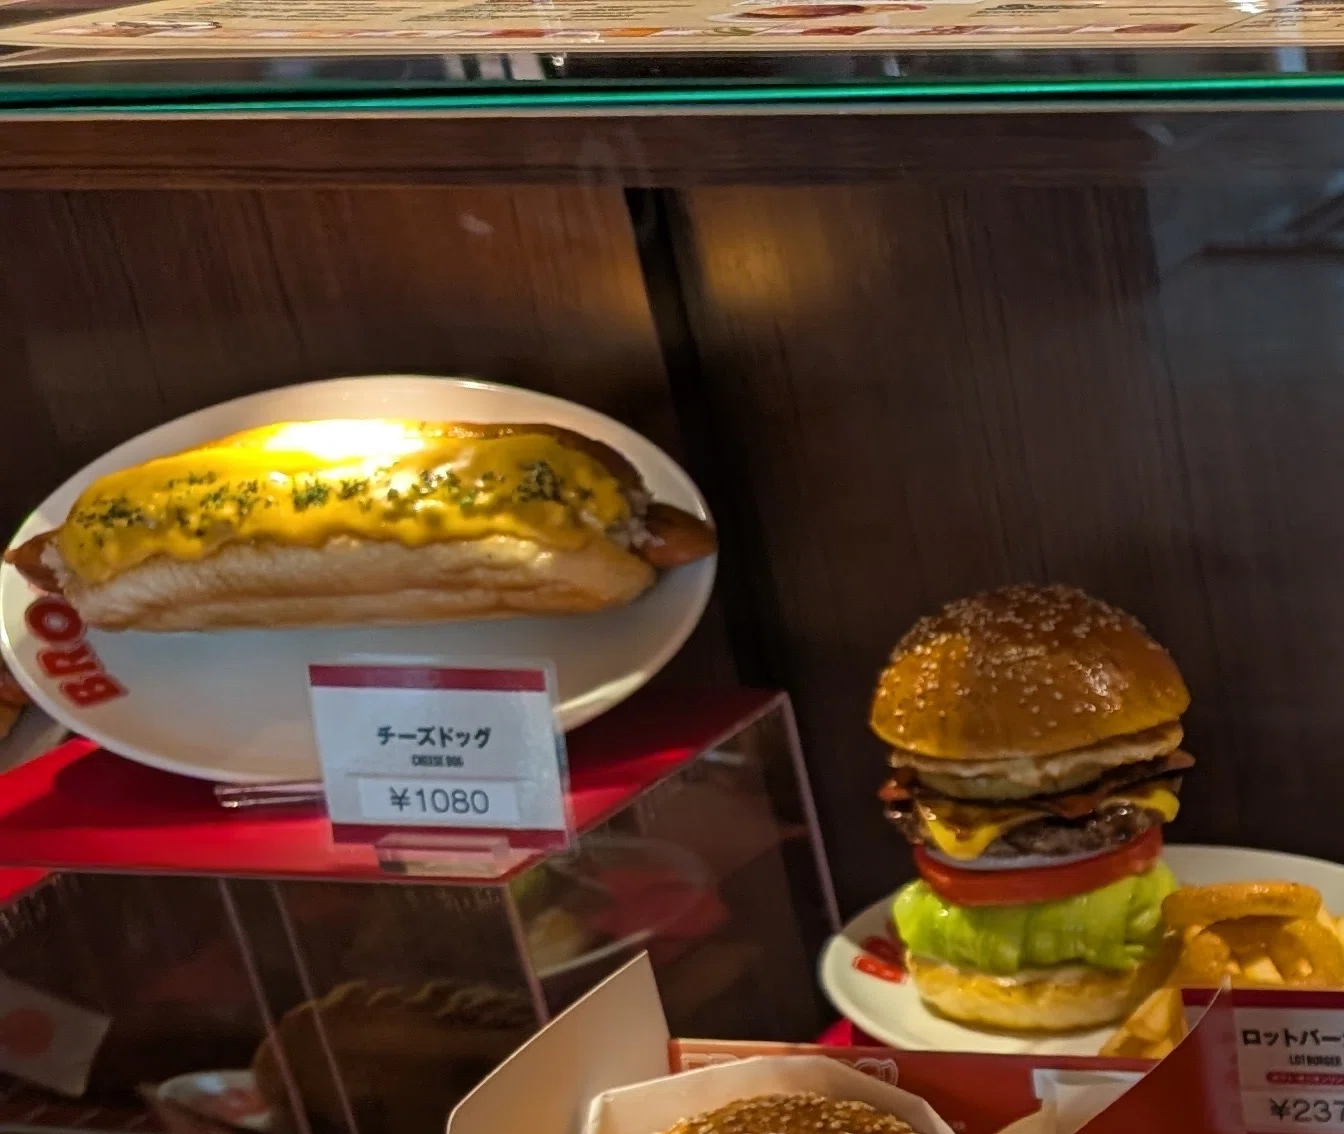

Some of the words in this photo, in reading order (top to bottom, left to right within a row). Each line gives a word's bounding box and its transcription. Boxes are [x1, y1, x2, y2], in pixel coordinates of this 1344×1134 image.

[377, 725, 492, 749] チーズドッグ
[388, 786, 490, 815] ¥1080
